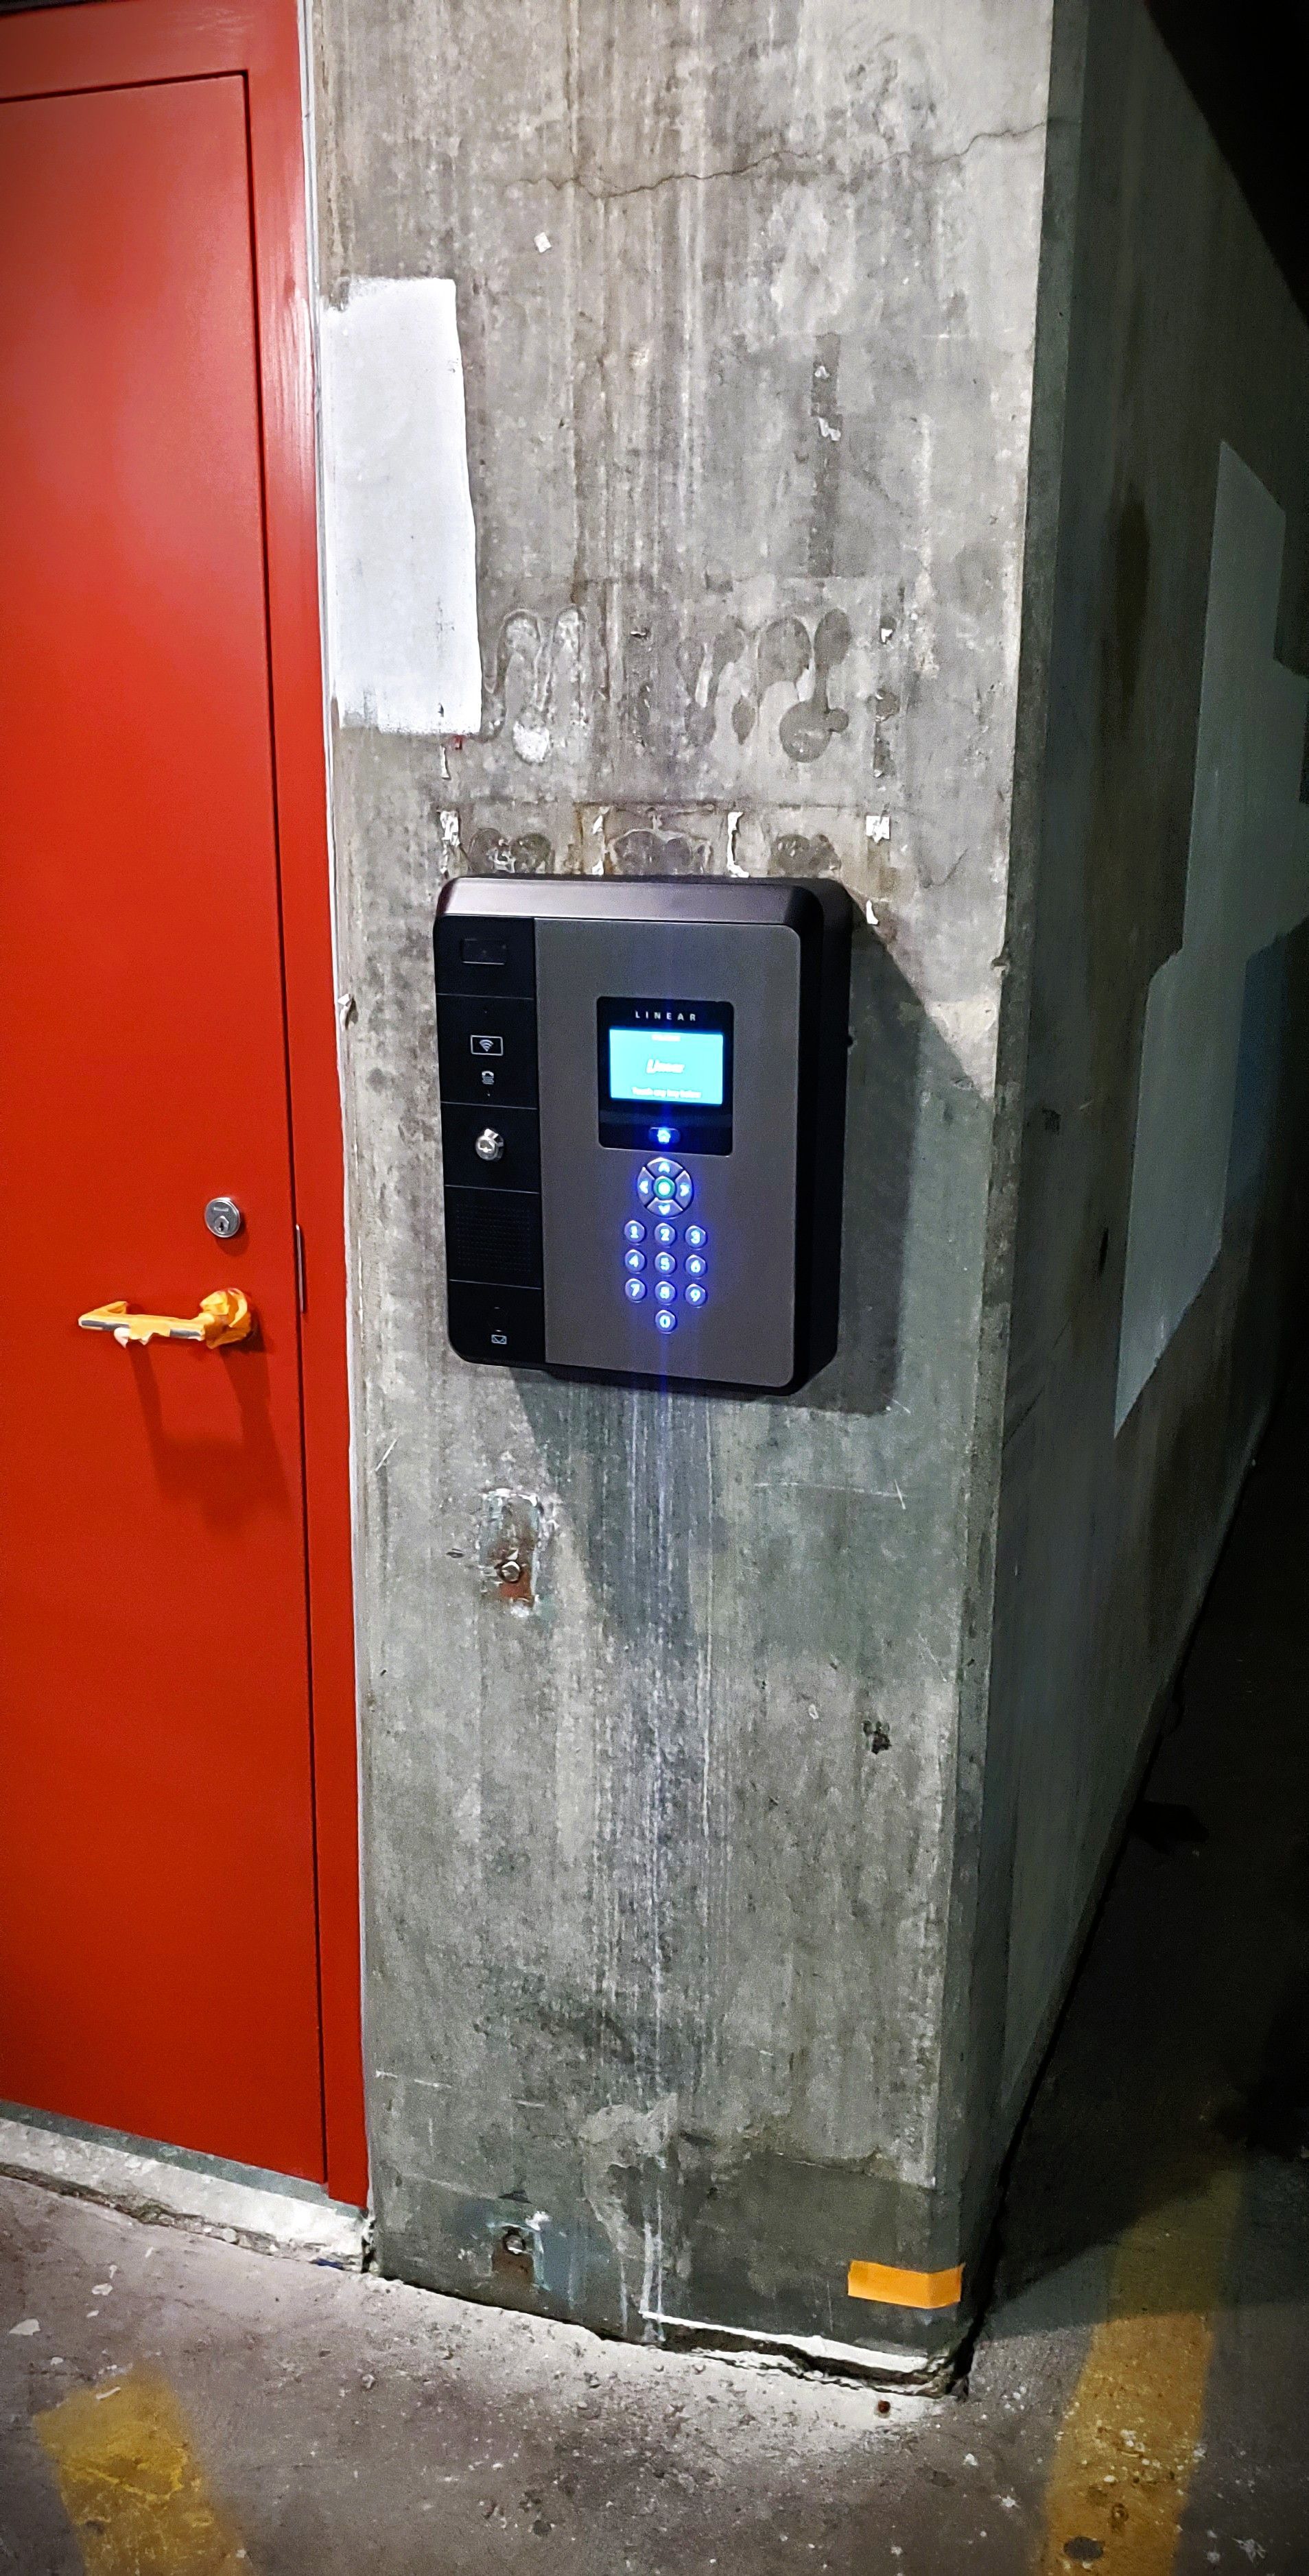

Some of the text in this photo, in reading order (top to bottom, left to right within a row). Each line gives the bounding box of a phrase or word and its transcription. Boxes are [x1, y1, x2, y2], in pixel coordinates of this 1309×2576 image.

[635, 1011, 696, 1021] LINEAR
[630, 1225, 700, 1244] 1 2 3
[628, 1255, 701, 1273] 4 5 6
[630, 1284, 701, 1302] 7 8 9
[659, 1314, 671, 1328] 0
